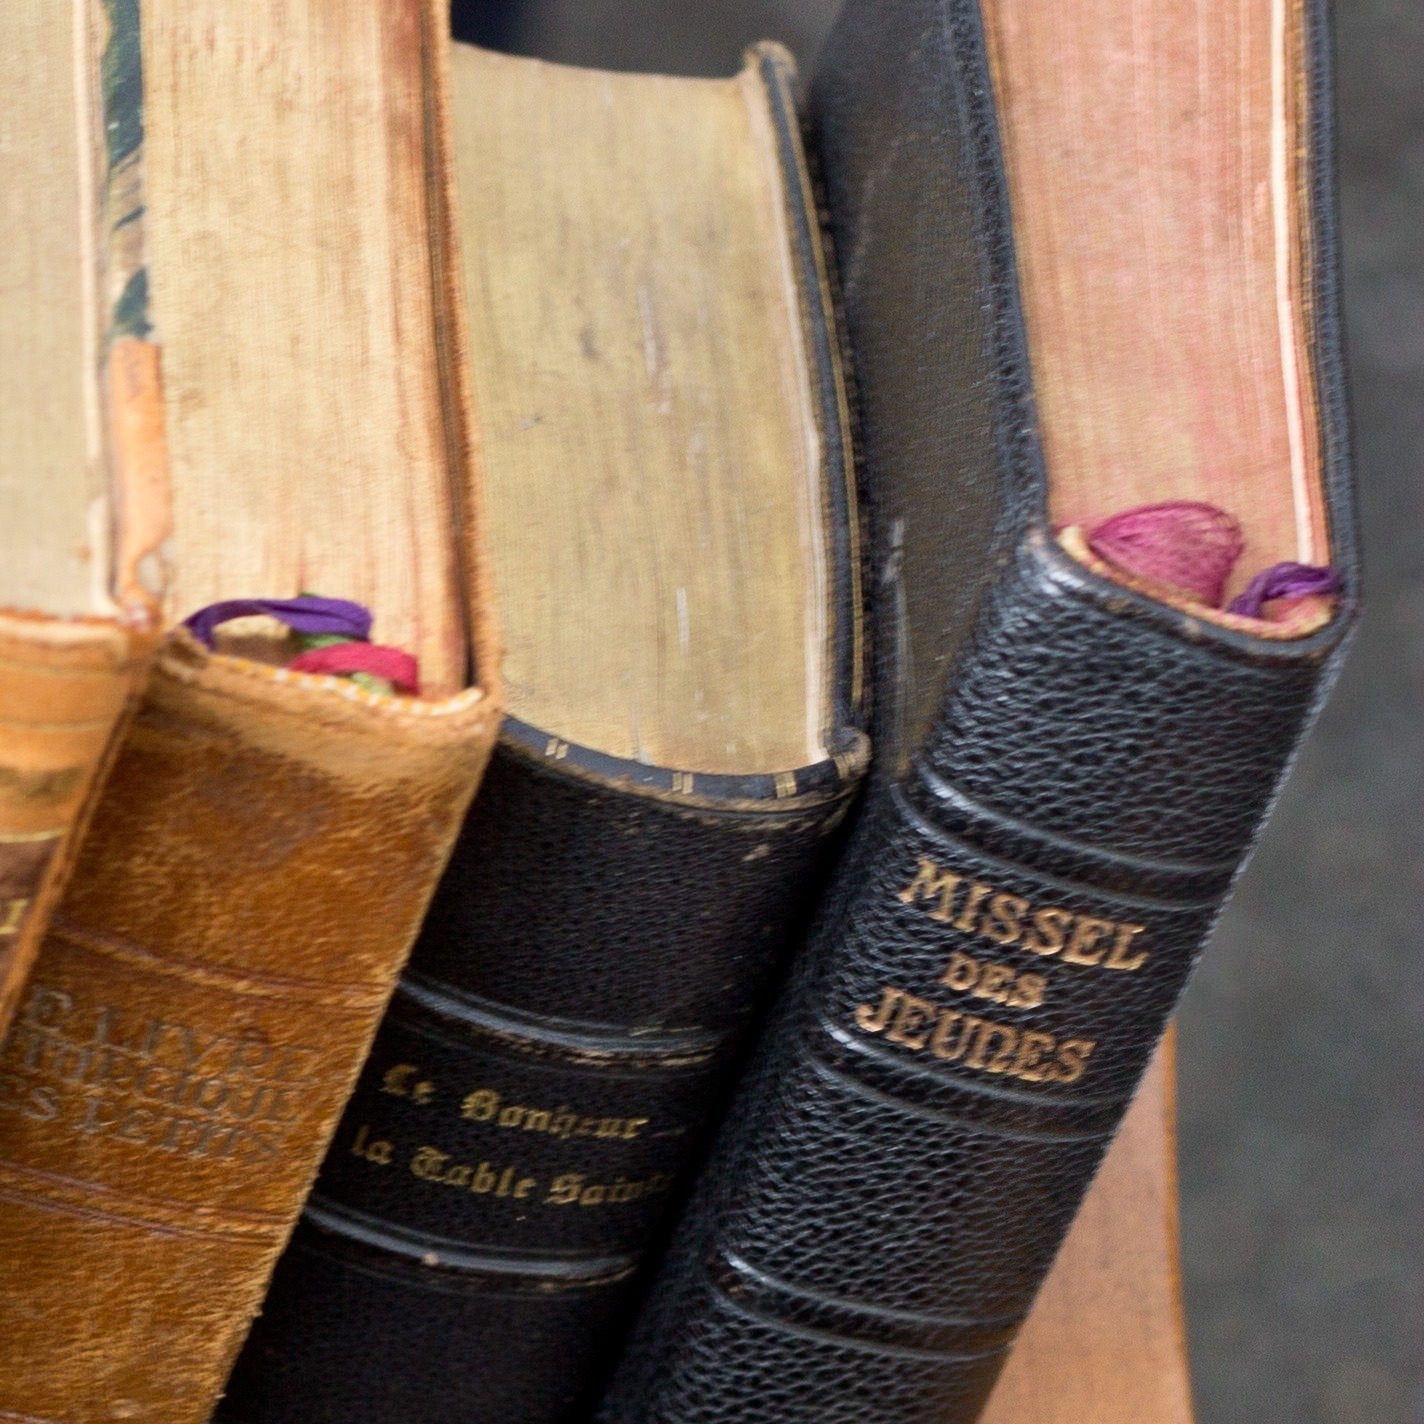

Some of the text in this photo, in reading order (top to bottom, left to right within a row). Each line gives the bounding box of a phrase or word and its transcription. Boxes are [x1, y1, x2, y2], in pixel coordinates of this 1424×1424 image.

[897, 856, 1151, 972] MISSEL
[938, 950, 1048, 1010] DES
[380, 1063, 651, 1141] Le Bonheur
[350, 1125, 393, 1165] la
[409, 1144, 536, 1199] Table
